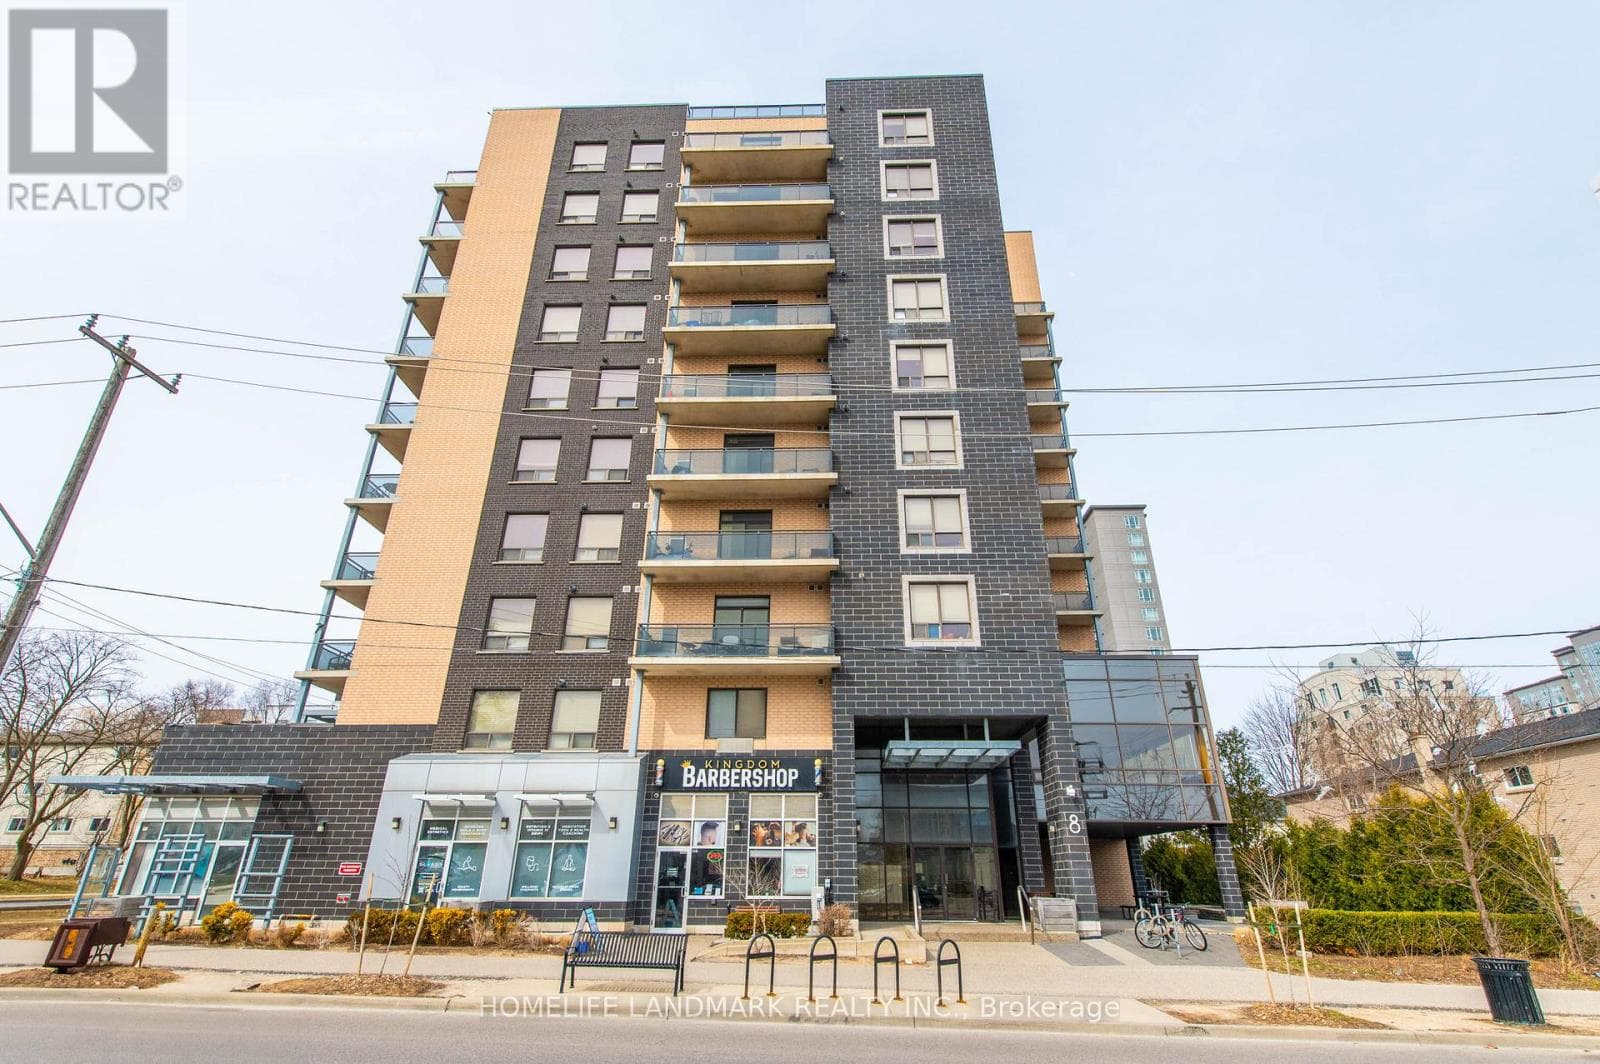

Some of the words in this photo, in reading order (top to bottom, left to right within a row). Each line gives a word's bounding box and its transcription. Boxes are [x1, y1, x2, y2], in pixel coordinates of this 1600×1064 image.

[705, 759, 781, 769] KINGDOM
[682, 766, 799, 788] BARBERSHOP
[1069, 814, 1081, 834] 8
